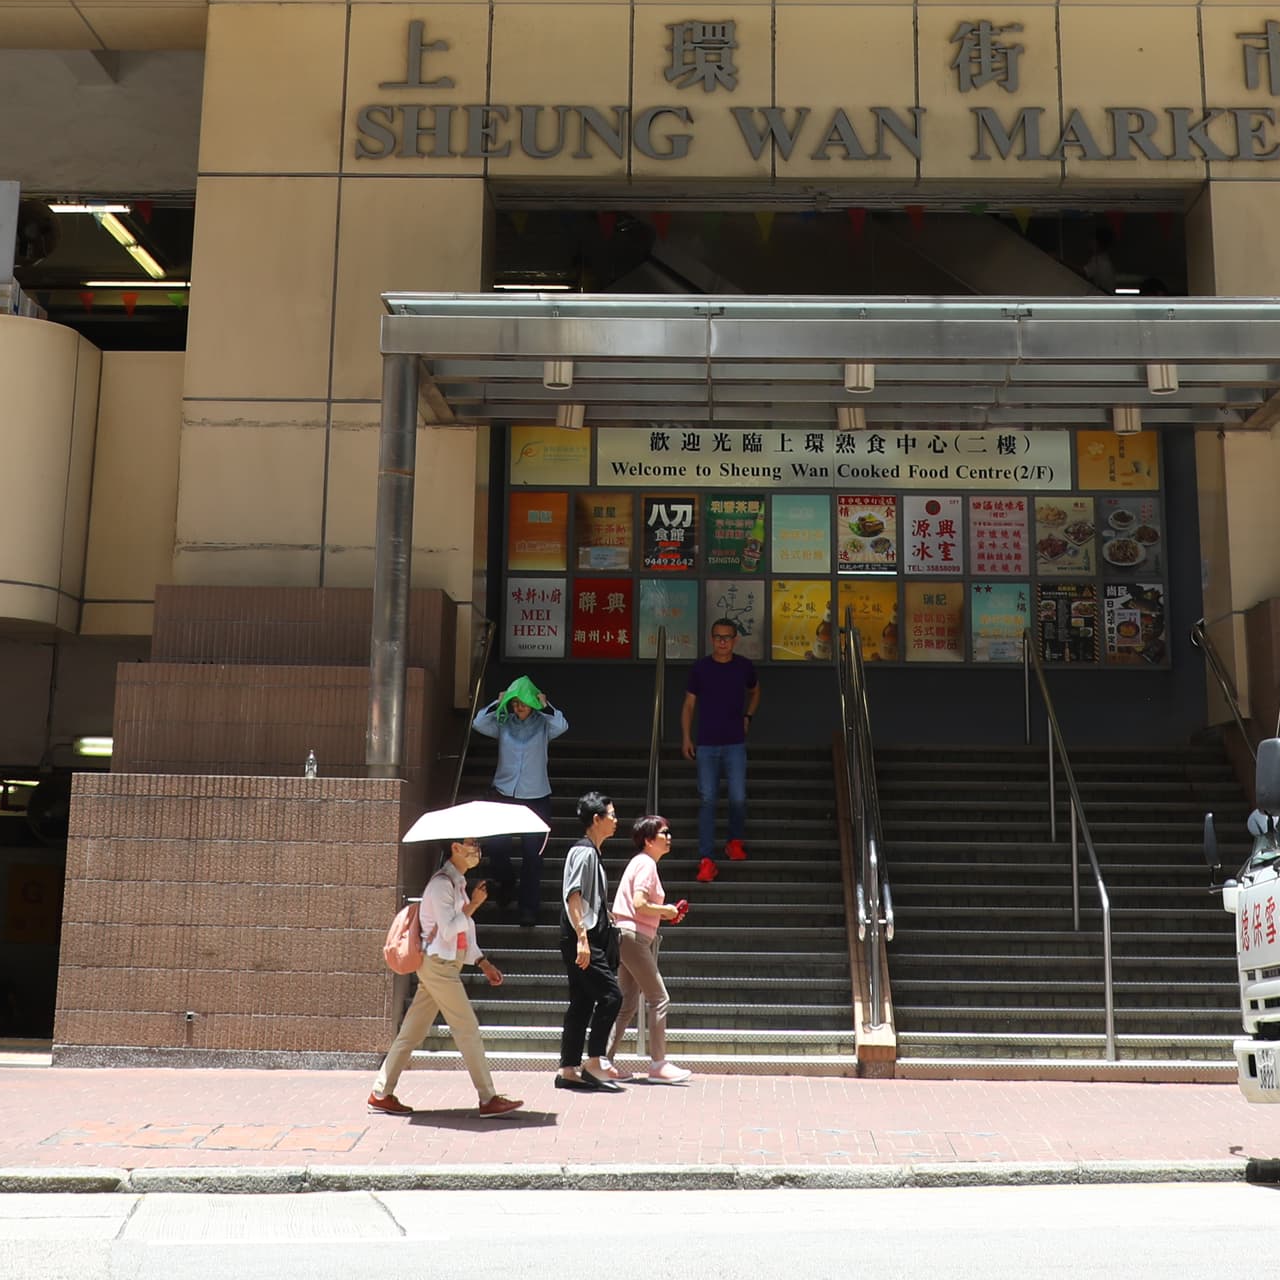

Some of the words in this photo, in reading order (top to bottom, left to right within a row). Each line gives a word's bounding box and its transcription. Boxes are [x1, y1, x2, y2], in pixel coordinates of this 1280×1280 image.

[354, 104, 695, 162] SHEUNG
[729, 105, 927, 162] WAN
[611, 461, 687, 477] Welcome
[696, 462, 712, 477] to
[719, 461, 782, 480] Sheung
[791, 463, 829, 478] Wan
[837, 463, 900, 479] Cooked
[909, 464, 949, 479] Food
[956, 464, 1054, 482] Centre(2/F)
[654, 527, 685, 542] 食館
[520, 608, 551, 622] MEI
[513, 624, 558, 638] HEEN
